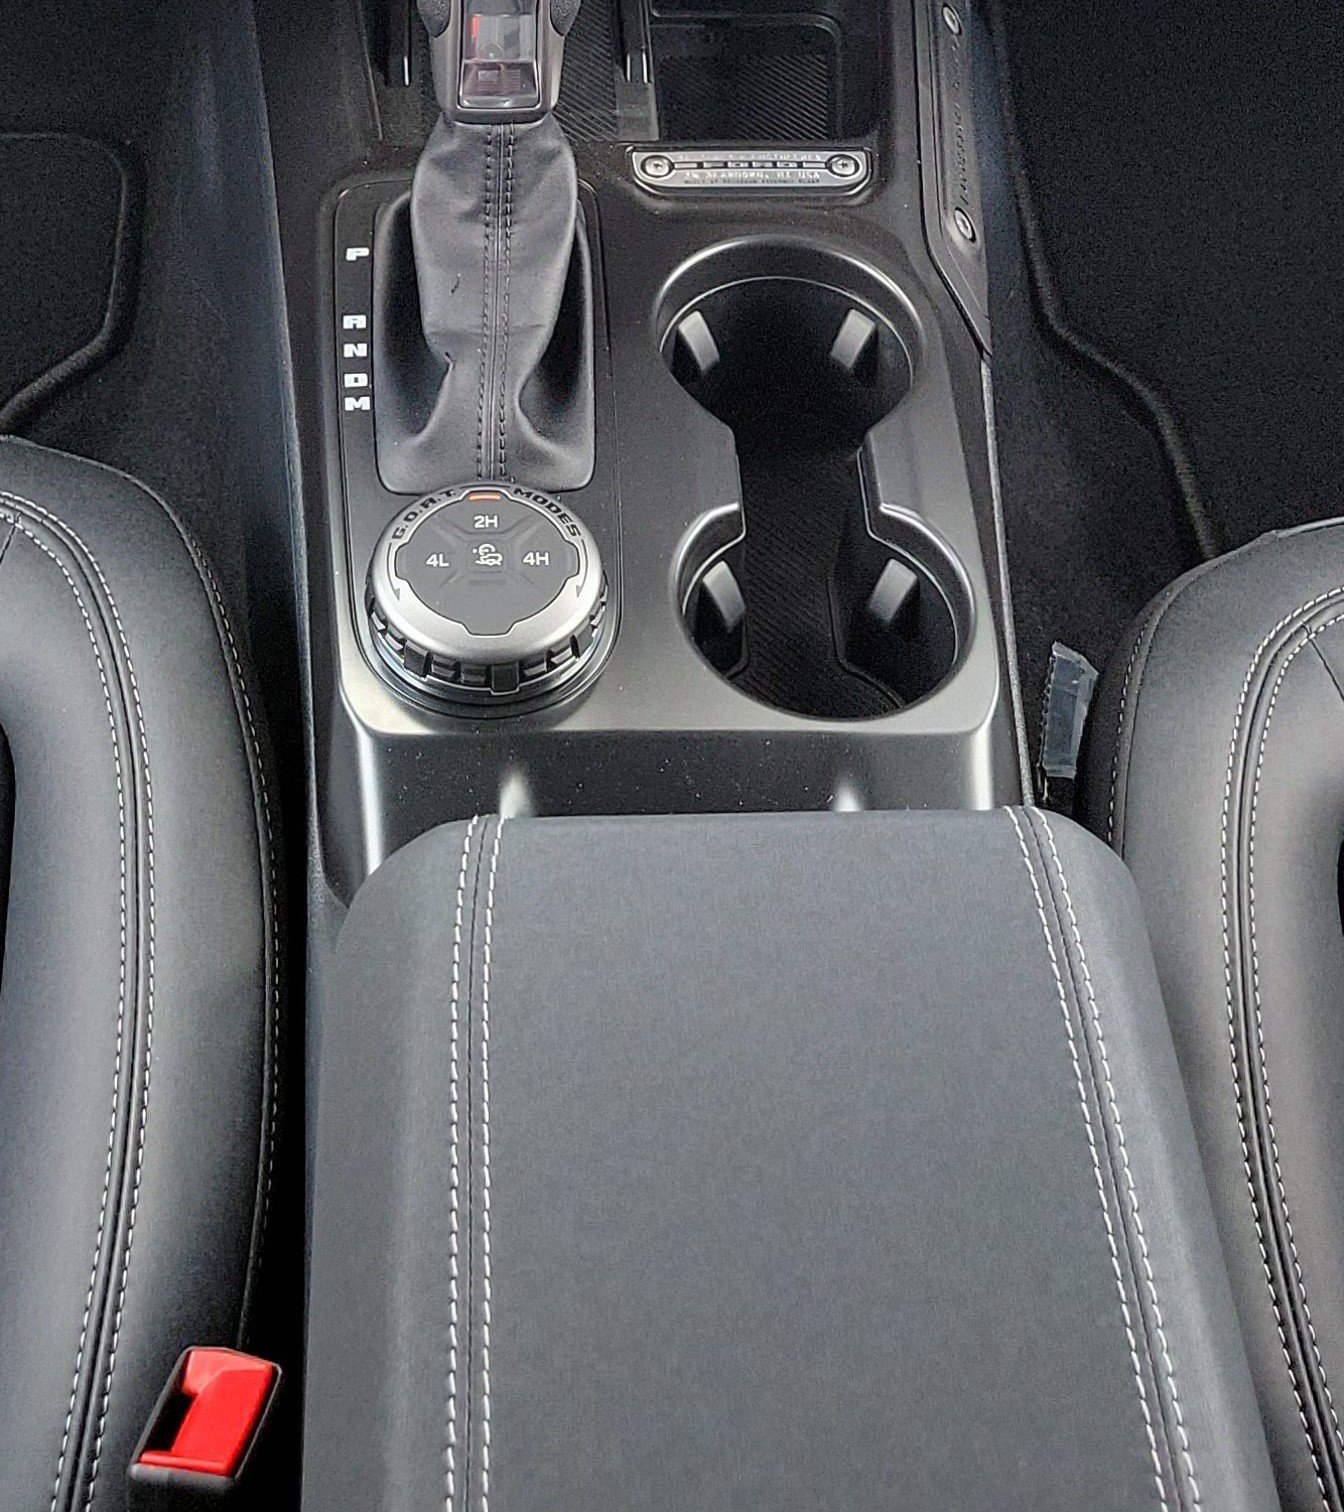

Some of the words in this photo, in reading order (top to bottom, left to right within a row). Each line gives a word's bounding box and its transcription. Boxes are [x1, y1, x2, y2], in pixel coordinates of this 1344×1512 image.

[346, 247, 370, 261] P
[343, 343, 368, 358] N
[344, 373, 368, 387] D
[344, 396, 371, 411] M
[513, 487, 582, 537] MODES
[473, 515, 498, 529] 2H
[425, 553, 449, 567] 4L
[522, 552, 550, 567] 4H
